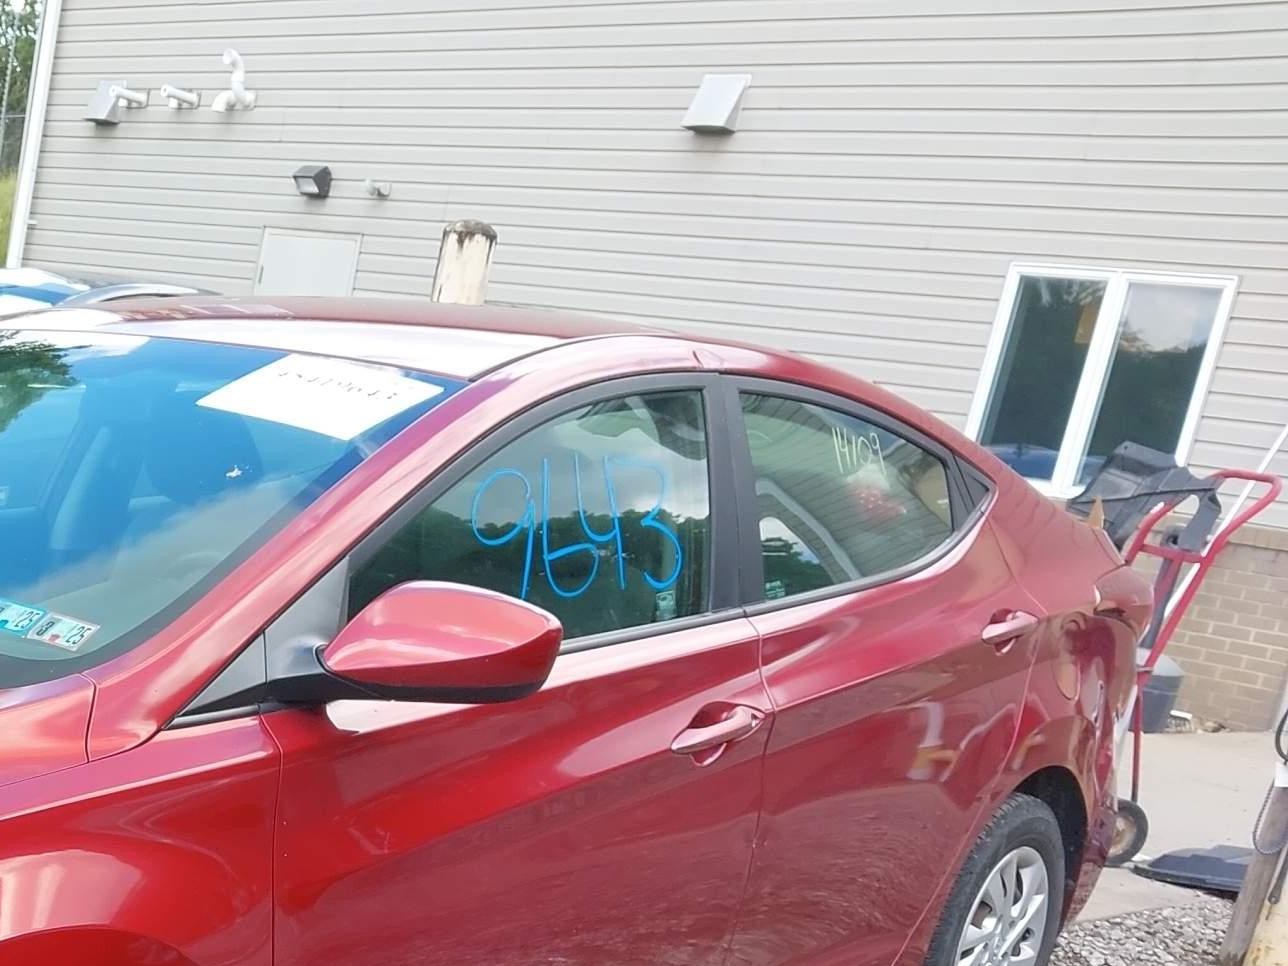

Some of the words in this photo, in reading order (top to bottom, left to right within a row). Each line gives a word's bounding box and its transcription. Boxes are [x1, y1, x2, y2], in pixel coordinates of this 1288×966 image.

[472, 453, 684, 600] 9643
[14, 610, 40, 628] 25
[66, 626, 92, 645] 25
